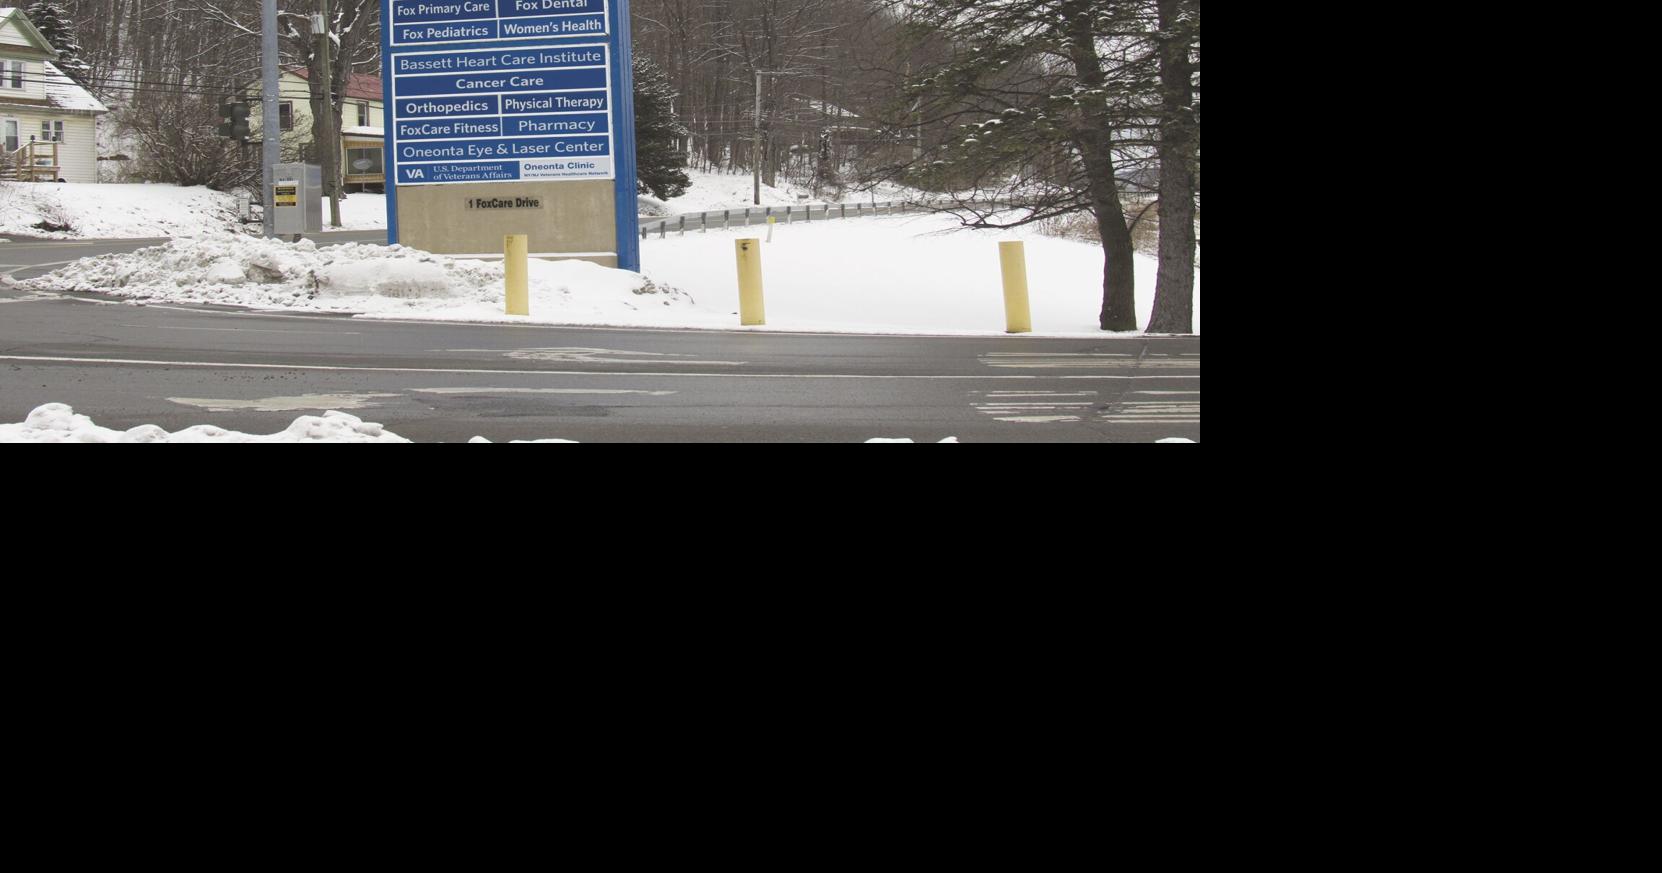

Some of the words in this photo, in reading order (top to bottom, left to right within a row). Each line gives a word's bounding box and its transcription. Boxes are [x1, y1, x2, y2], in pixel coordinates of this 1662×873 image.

[397, 6, 416, 16] Fox
[419, 4, 461, 15] Primary
[464, 2, 490, 12] Care
[515, 0, 538, 11] Fox
[542, 0, 588, 9] Dental
[403, 28, 424, 39] Fox
[427, 26, 489, 38] Pediatrics
[504, 21, 559, 35] Women's
[562, 19, 602, 32] Health
[401, 58, 453, 70] Bassett
[456, 55, 497, 68] Heart
[501, 54, 536, 66] Care
[539, 51, 601, 64] Institute
[456, 78, 506, 89] Cancer
[510, 76, 544, 87] Care
[406, 101, 488, 116] Orthopedics
[505, 97, 552, 112] Physical
[554, 96, 604, 111] Therapy
[400, 122, 450, 136] FoxCare
[454, 121, 499, 134] Fitness
[518, 119, 596, 133] Pharmacy
[403, 146, 464, 158] Oneonta
[468, 145, 493, 160] Eye
[496, 144, 509, 155] &
[512, 143, 551, 154] Laser
[554, 141, 604, 153] Center
[433, 165, 450, 173] U.S.
[451, 163, 502, 174] Department
[524, 163, 565, 171] Oneonta
[567, 162, 595, 170] Clinic
[406, 169, 424, 179] VA
[440, 172, 480, 180] Veterans
[482, 171, 512, 179] Affairs
[469, 200, 473, 208] 1
[476, 198, 514, 209] FoxCare
[516, 197, 539, 208] Drive
